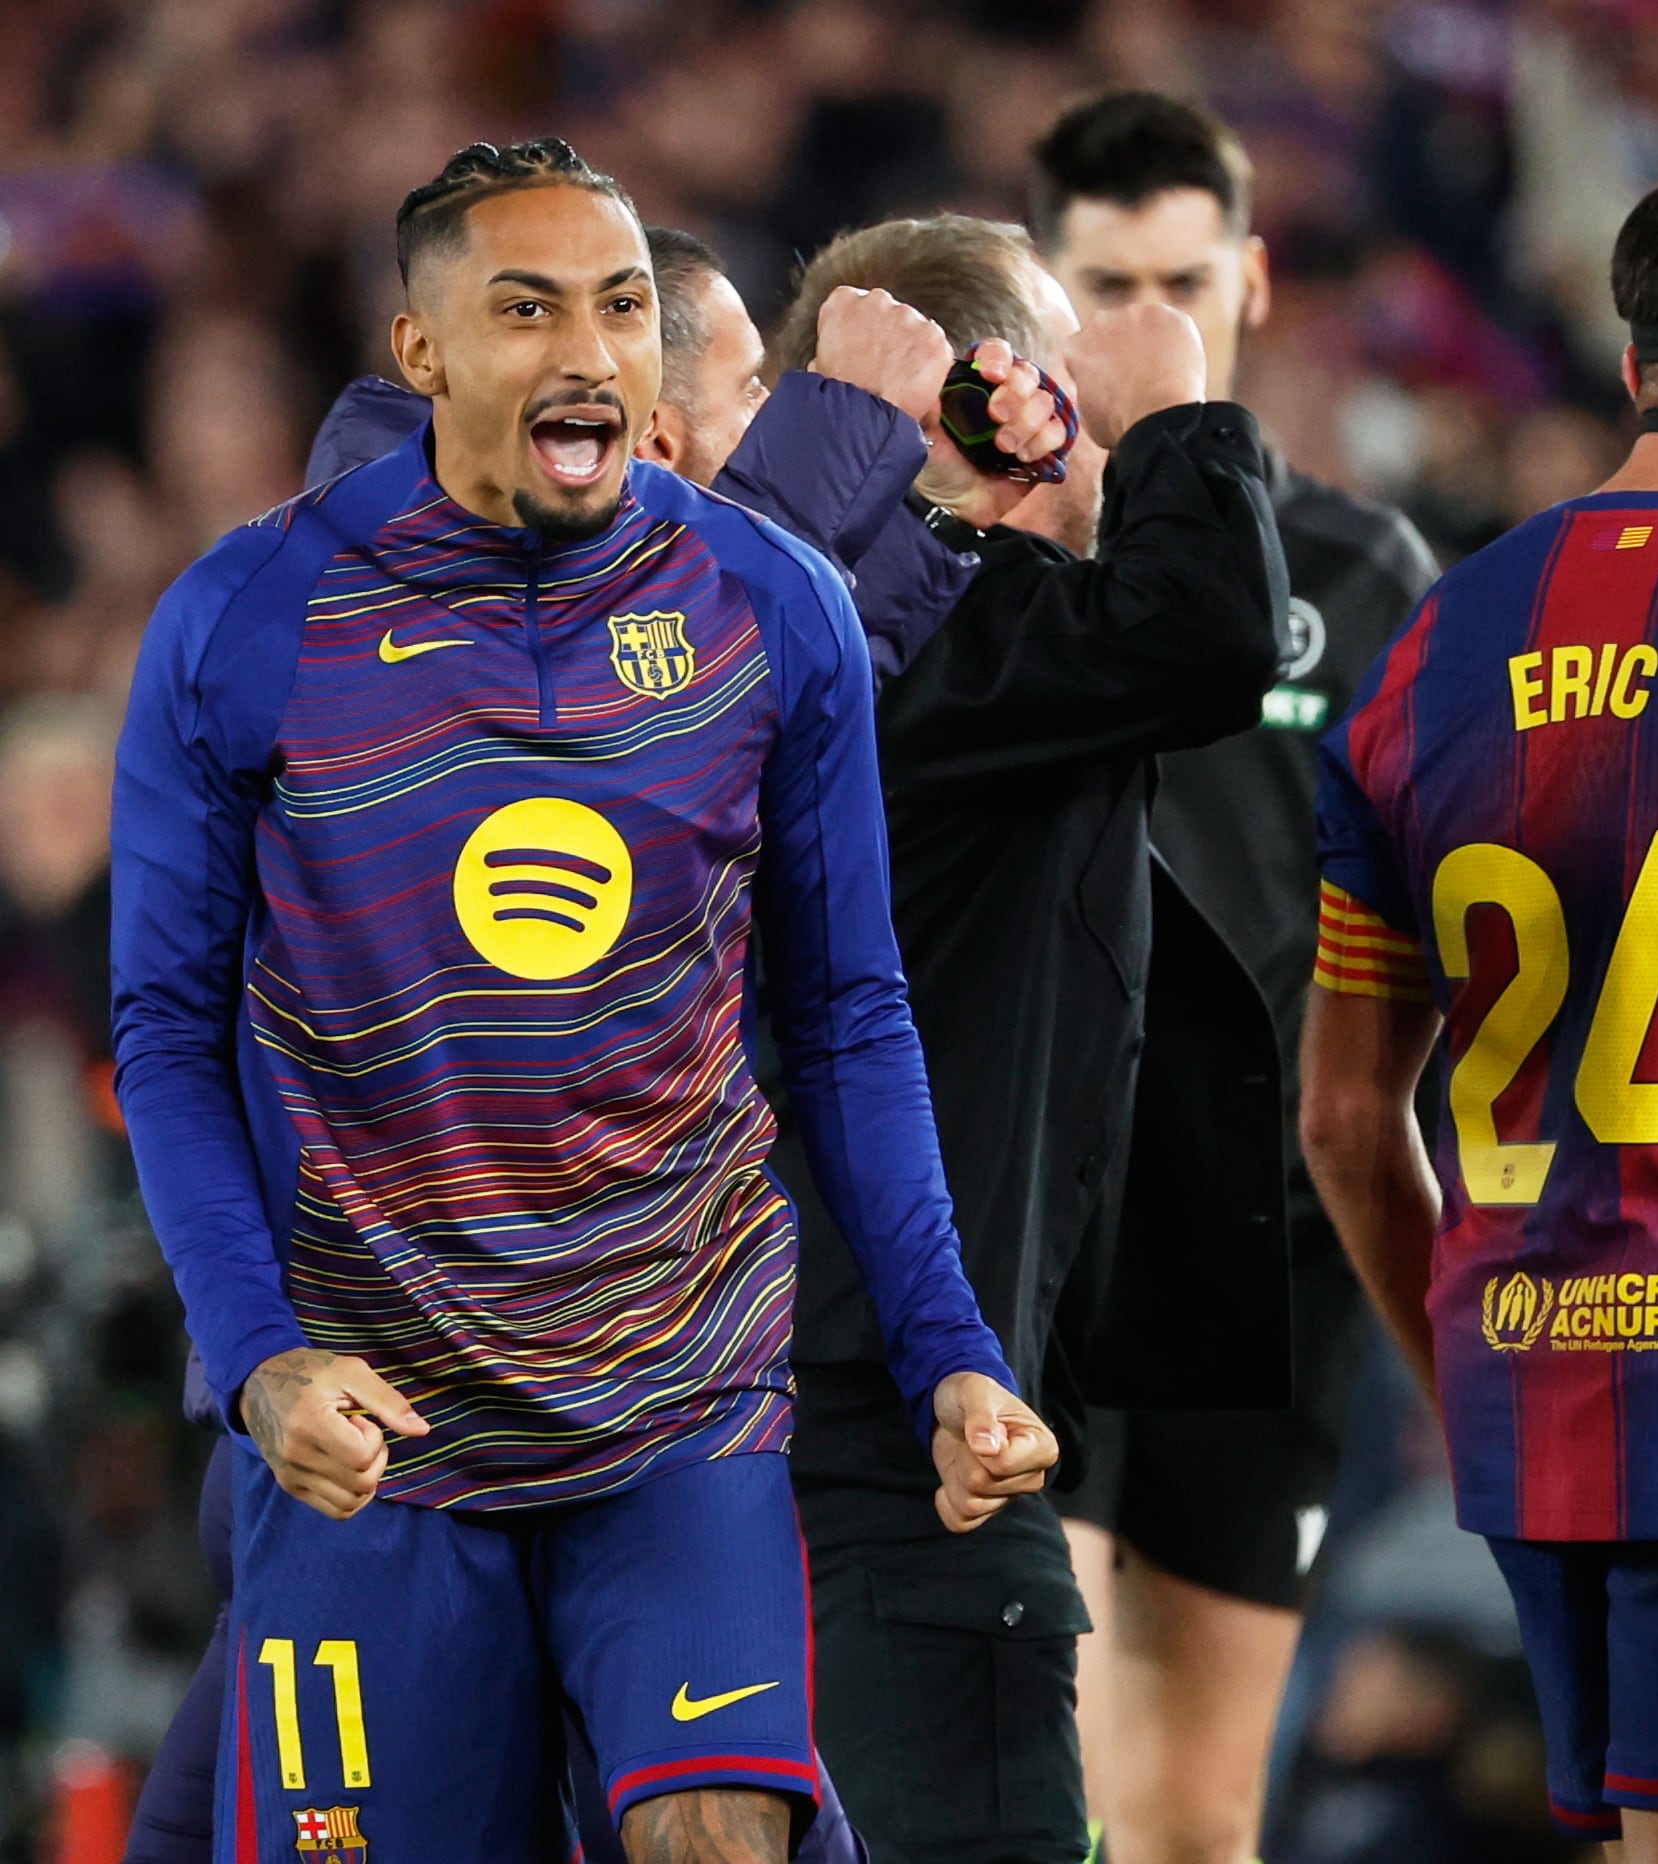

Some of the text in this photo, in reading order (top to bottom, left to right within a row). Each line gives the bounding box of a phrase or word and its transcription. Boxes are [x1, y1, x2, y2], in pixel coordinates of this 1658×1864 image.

[1509, 643, 1658, 731] ERIC
[1550, 1338, 1567, 1351] The
[1568, 1338, 1582, 1351] UN
[1585, 1339, 1625, 1352] Refugee
[258, 1638, 371, 1789] 11
